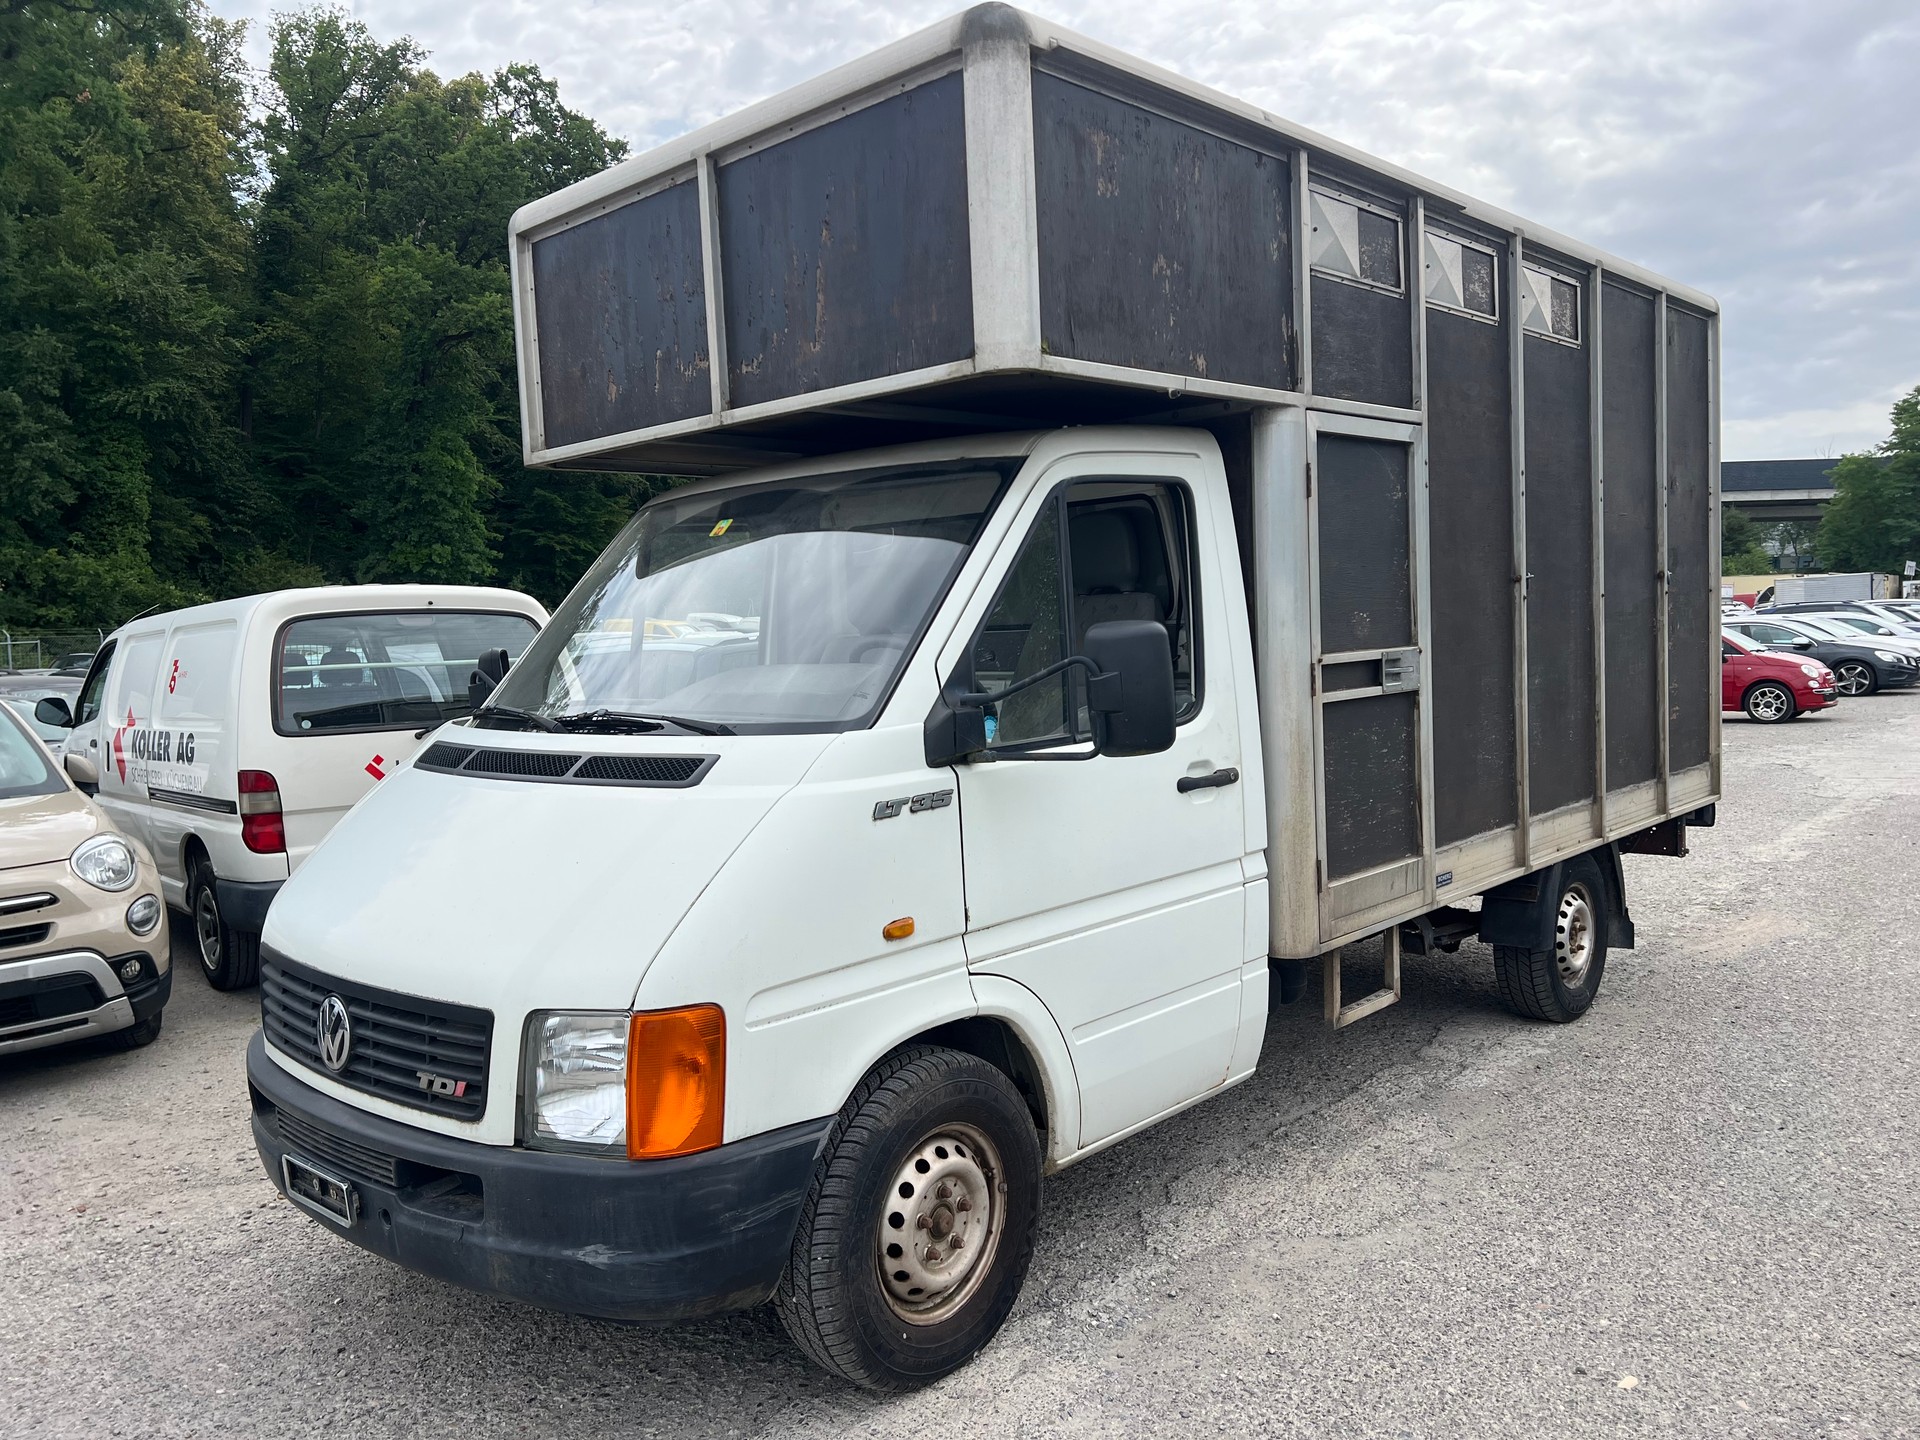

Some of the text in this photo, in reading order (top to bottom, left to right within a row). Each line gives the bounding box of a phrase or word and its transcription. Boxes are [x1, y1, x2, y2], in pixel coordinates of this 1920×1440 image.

[132, 730, 195, 766] KOLLER AG
[873, 789, 954, 820] LT 35
[416, 1071, 467, 1097] TDI
